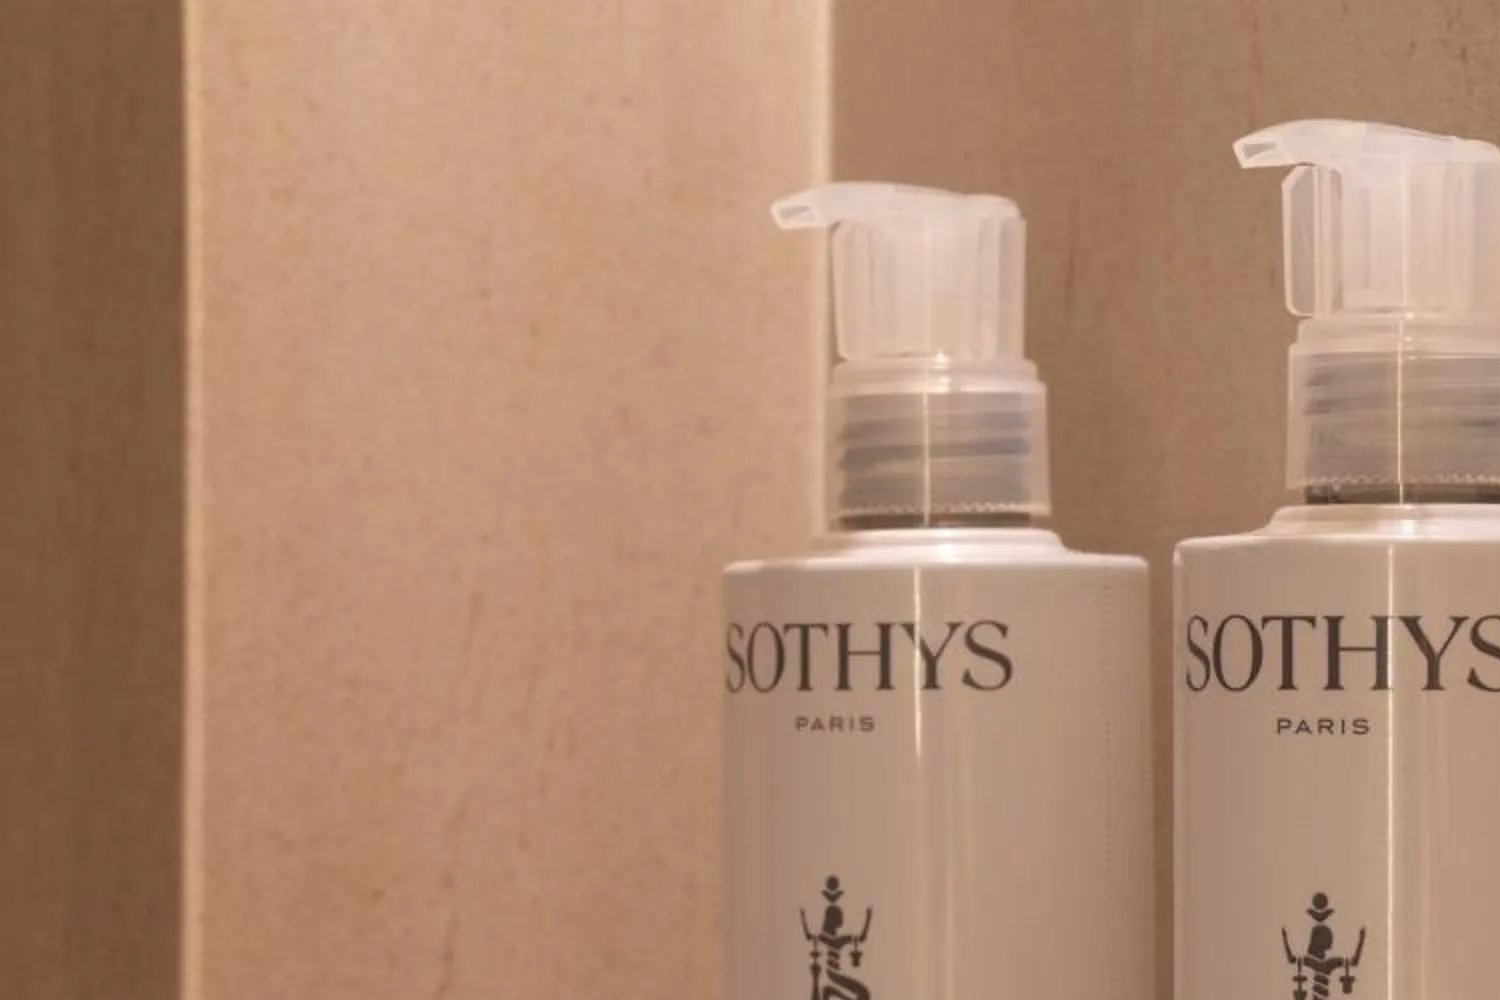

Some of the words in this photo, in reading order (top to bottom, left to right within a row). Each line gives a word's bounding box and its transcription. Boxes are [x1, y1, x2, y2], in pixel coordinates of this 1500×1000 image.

[725, 619, 1013, 694] SOTHYS
[795, 716, 876, 732] PARIS
[1276, 717, 1371, 735] PARIS
